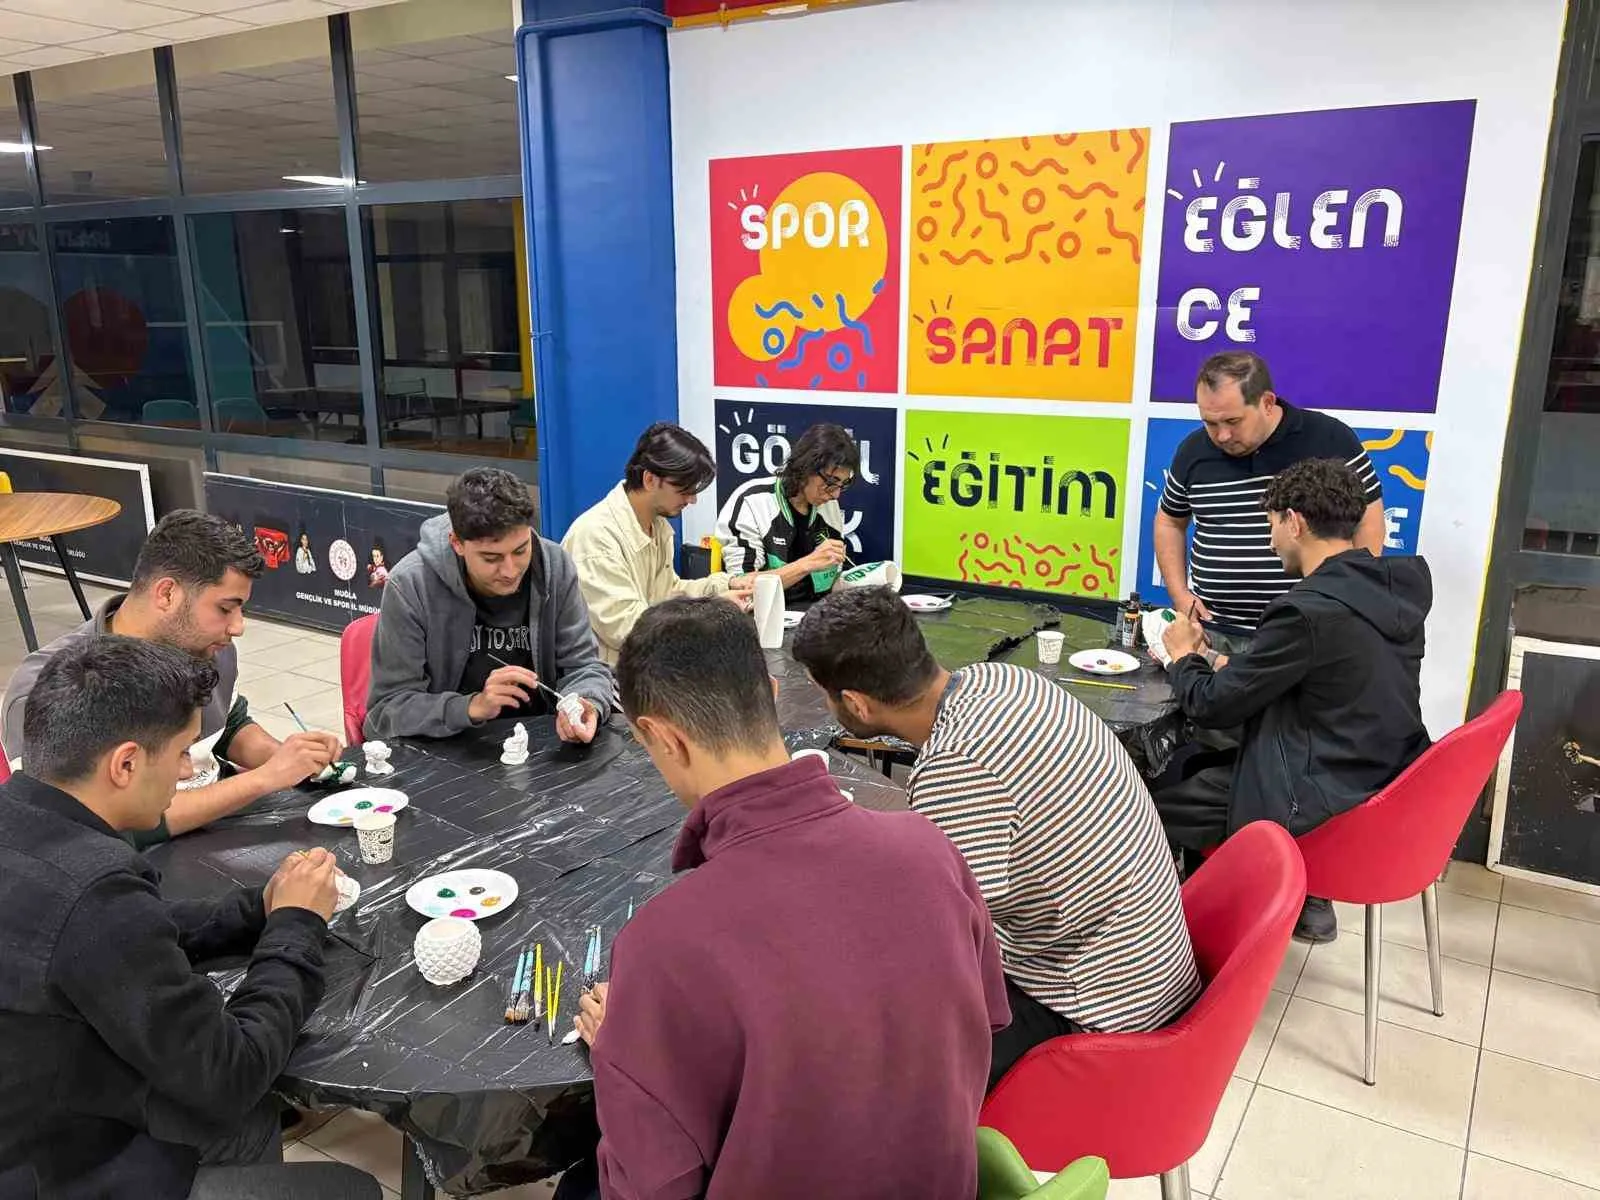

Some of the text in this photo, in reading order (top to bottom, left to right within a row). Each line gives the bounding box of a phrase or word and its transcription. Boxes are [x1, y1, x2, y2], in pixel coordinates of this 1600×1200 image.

[739, 199, 870, 250] SPOR
[1183, 177, 1404, 253] EĞLEN
[925, 315, 1123, 368] SANAT
[1176, 287, 1261, 343] CE
[732, 424, 880, 486] GÖL
[923, 450, 1118, 519] EĞİTİM
[296, 591, 323, 604] GENÇLİK
[333, 600, 350, 609] SPOR
[334, 589, 357, 600] MUĞLA
[487, 627, 505, 650] TO
